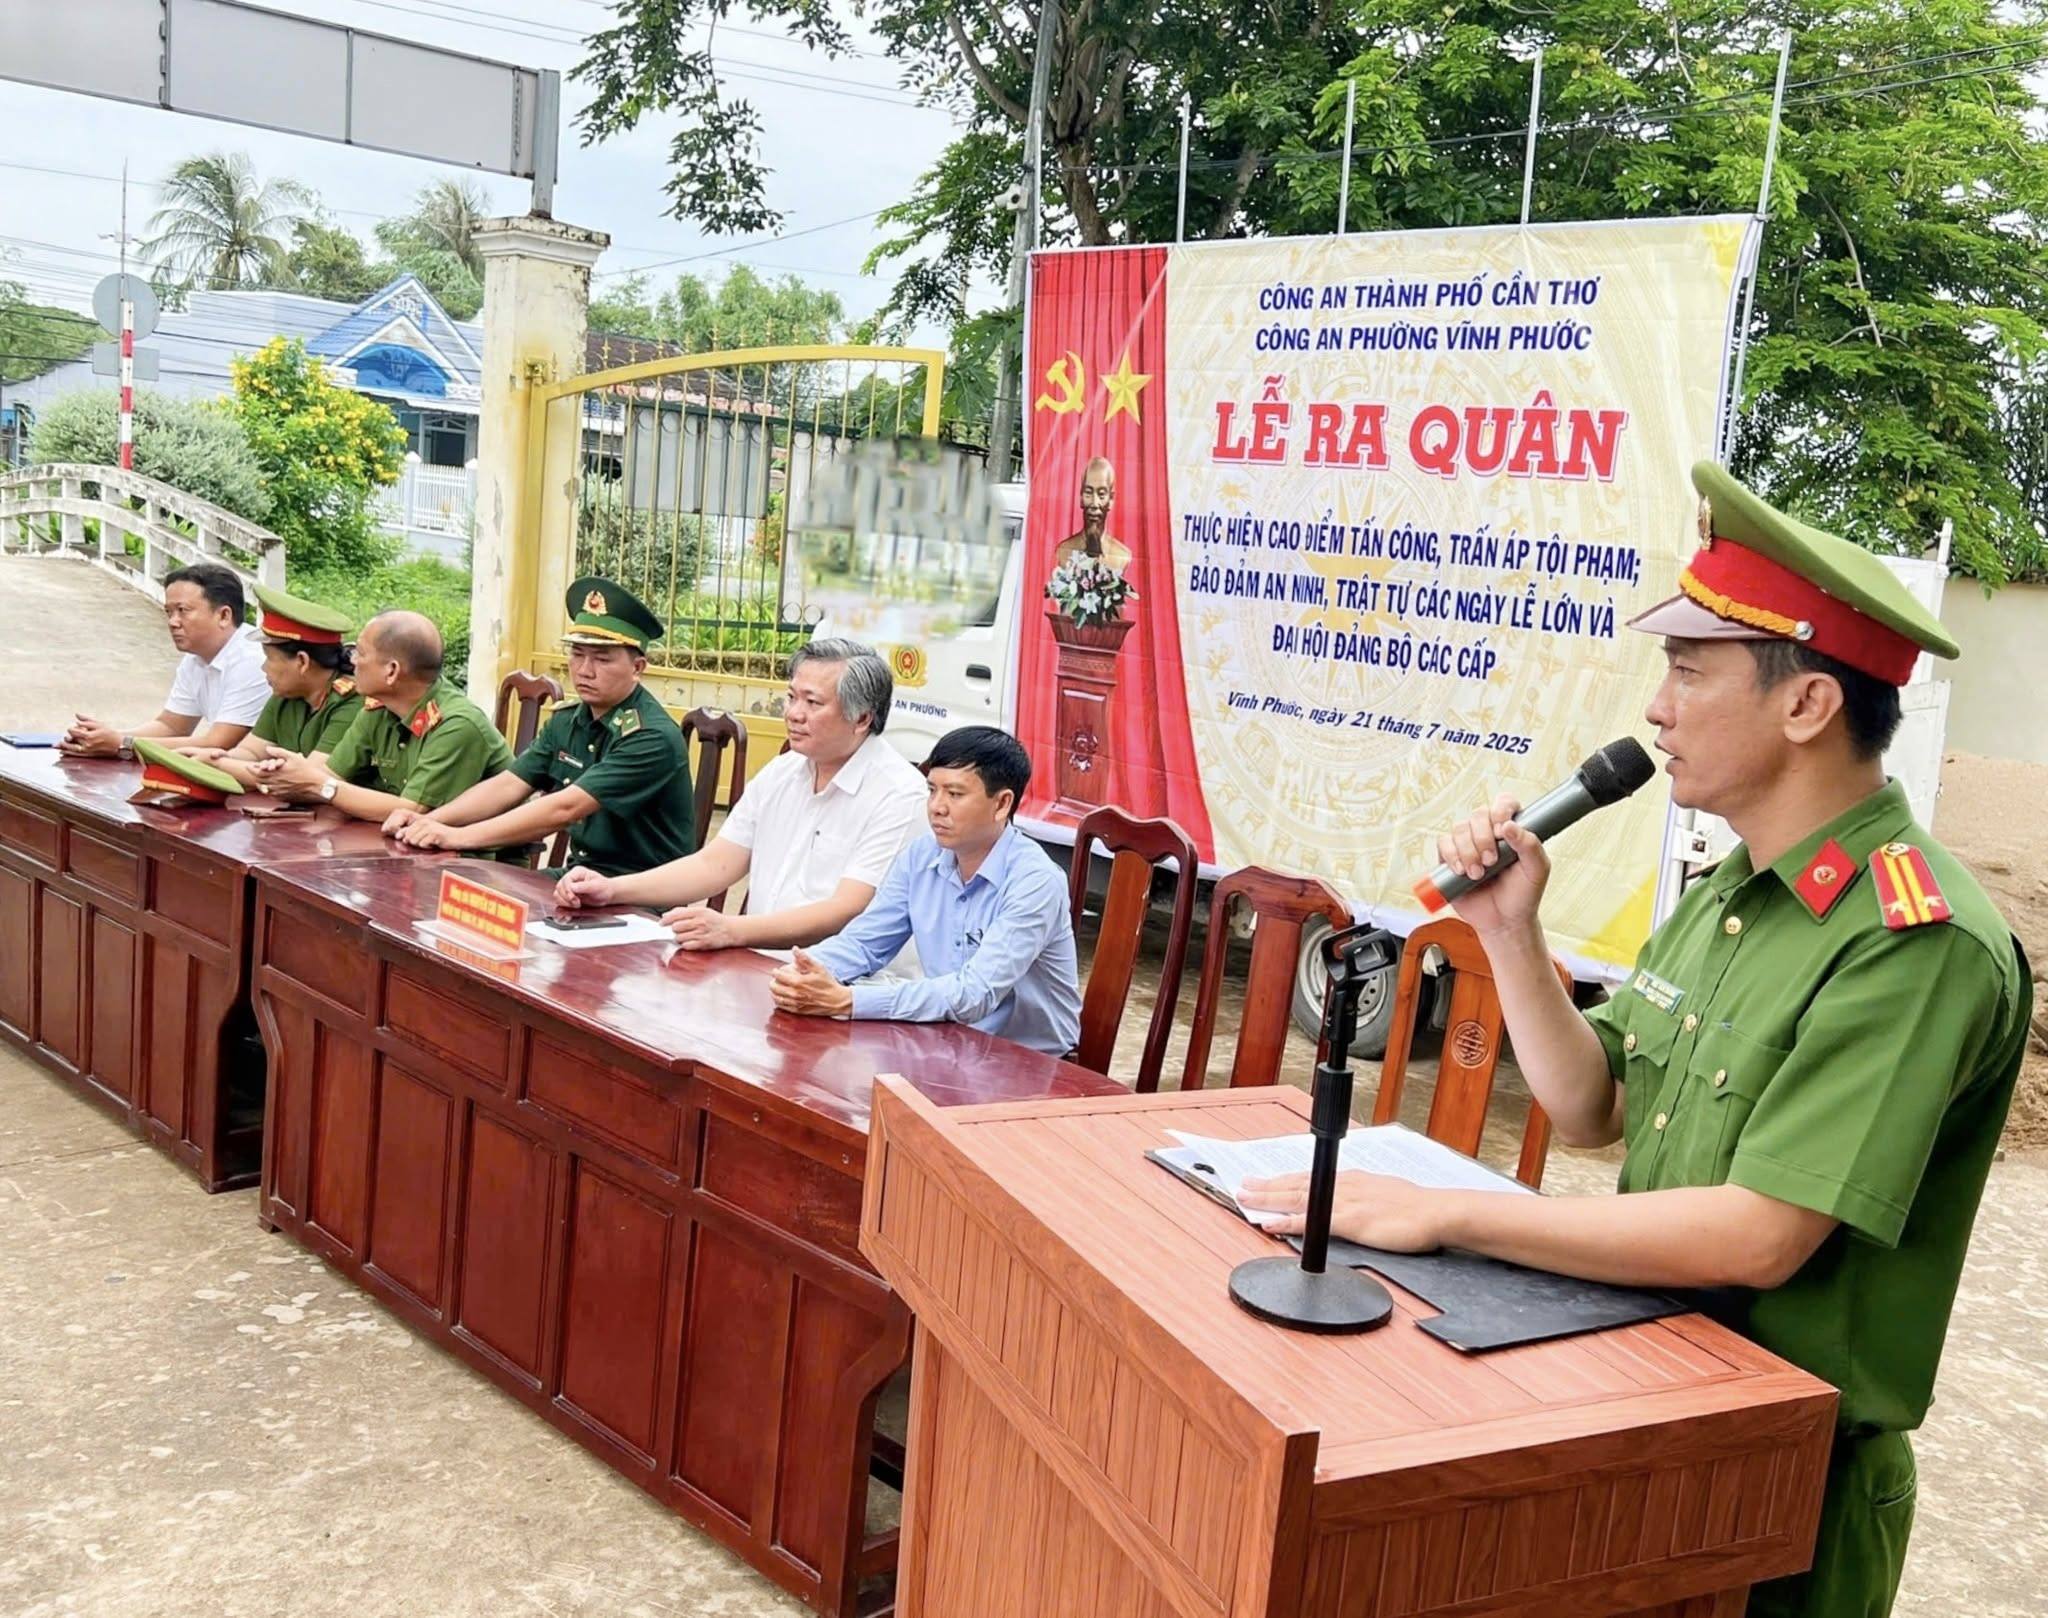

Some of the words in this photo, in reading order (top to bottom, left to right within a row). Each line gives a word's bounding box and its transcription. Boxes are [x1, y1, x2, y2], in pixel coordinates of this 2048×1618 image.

[1259, 280, 1313, 311] CÔNG
[1320, 286, 1347, 309] AN
[1355, 276, 1428, 308] THÀNH
[1435, 271, 1489, 307] PHỐ
[1491, 270, 1537, 306] CẦN
[1549, 275, 1601, 306] THƠ
[1255, 321, 1310, 351] CÔNG
[1316, 327, 1343, 350] AN
[1348, 320, 1439, 351] PHƯỜNG
[1446, 319, 1500, 350] VĨNH
[1509, 317, 1592, 351] PHƯỚC
[1212, 374, 1291, 464] LỄ
[1304, 402, 1389, 470] RA
[1408, 389, 1628, 482] QUÂN
[1183, 512, 1222, 548] THỰC
[1226, 511, 1264, 552] HIỆN
[1268, 518, 1301, 551] CAO
[1303, 509, 1344, 556] ĐIỂM
[1350, 515, 1385, 559] TẤN
[1387, 522, 1442, 567] CÔNG,
[1449, 523, 1499, 570] TRẤN
[1502, 527, 1531, 571] ÁP
[1536, 534, 1569, 578] TỘI
[1574, 544, 1642, 587] PHẠM;
[1189, 554, 1220, 594] BẢO
[1224, 559, 1261, 600] ĐẢM
[1264, 570, 1287, 602] AN
[1291, 573, 1330, 611] NINH,
[1336, 572, 1382, 614] TRẬT
[1386, 580, 1413, 619] TỰ
[1415, 579, 1451, 621] CÁC
[1455, 586, 1505, 628] NGÀY
[1510, 582, 1537, 632] LỄ
[1541, 596, 1584, 636] LỚN
[1587, 597, 1616, 639] VÀ
[1273, 624, 1299, 658] ĐẠI
[1302, 622, 1329, 662] HỘI
[1333, 621, 1382, 666] ĐẢNG
[1386, 630, 1413, 674] BỘ
[1417, 634, 1452, 676] CÁC
[1456, 636, 1497, 681] CẤP
[895, 700, 907, 710] AN
[1227, 689, 1260, 712] Vĩnh
[1262, 695, 1304, 720] Phước,
[1309, 706, 1347, 727] ngày
[1350, 710, 1372, 729] 21
[1376, 713, 1424, 739] tháng
[1428, 722, 1440, 740] 7
[1443, 726, 1480, 748] năm
[1484, 730, 1533, 755] 2025
